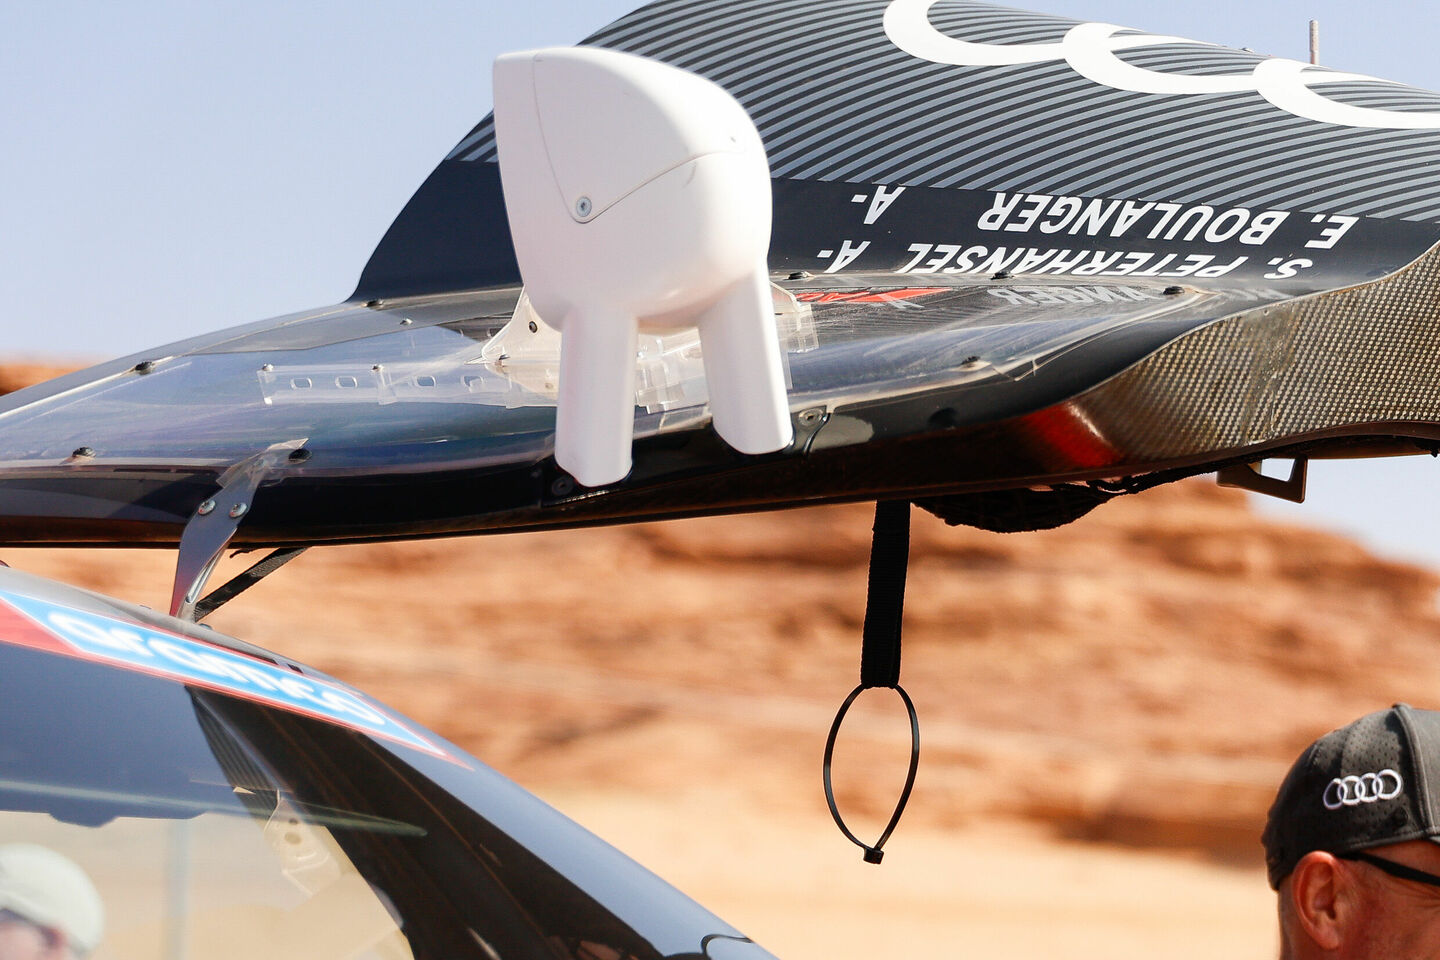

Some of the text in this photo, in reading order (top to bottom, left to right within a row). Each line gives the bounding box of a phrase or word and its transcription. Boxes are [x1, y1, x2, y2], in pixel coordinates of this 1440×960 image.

[851, 185, 1360, 249] E. BOULANGER A-
[816, 239, 1314, 280] S. PETERHANSEL A-
